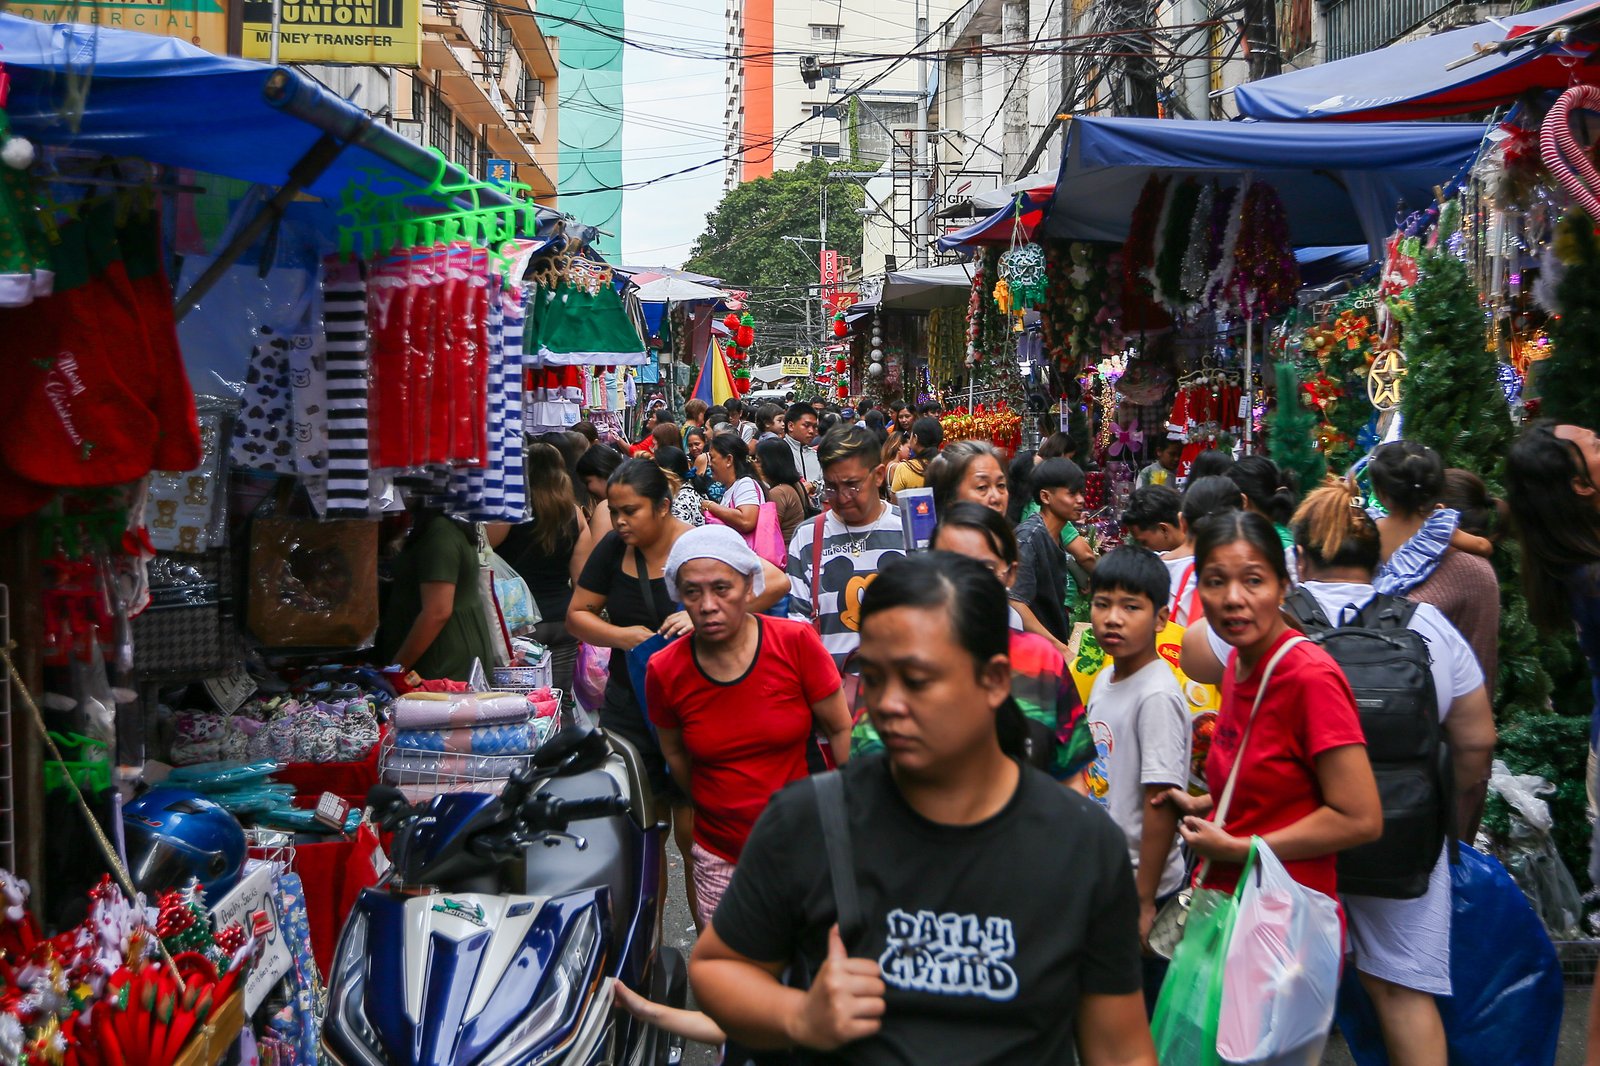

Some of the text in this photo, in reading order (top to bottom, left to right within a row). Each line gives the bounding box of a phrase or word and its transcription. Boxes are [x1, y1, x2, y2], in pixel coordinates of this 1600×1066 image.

[283, 6, 373, 24] UNION
[256, 32, 392, 47] MNEY TRANSFER
[824, 252, 835, 298] PBCOM
[59, 351, 86, 397] Merry
[783, 357, 808, 365] MAR
[45, 371, 82, 446] Christmas
